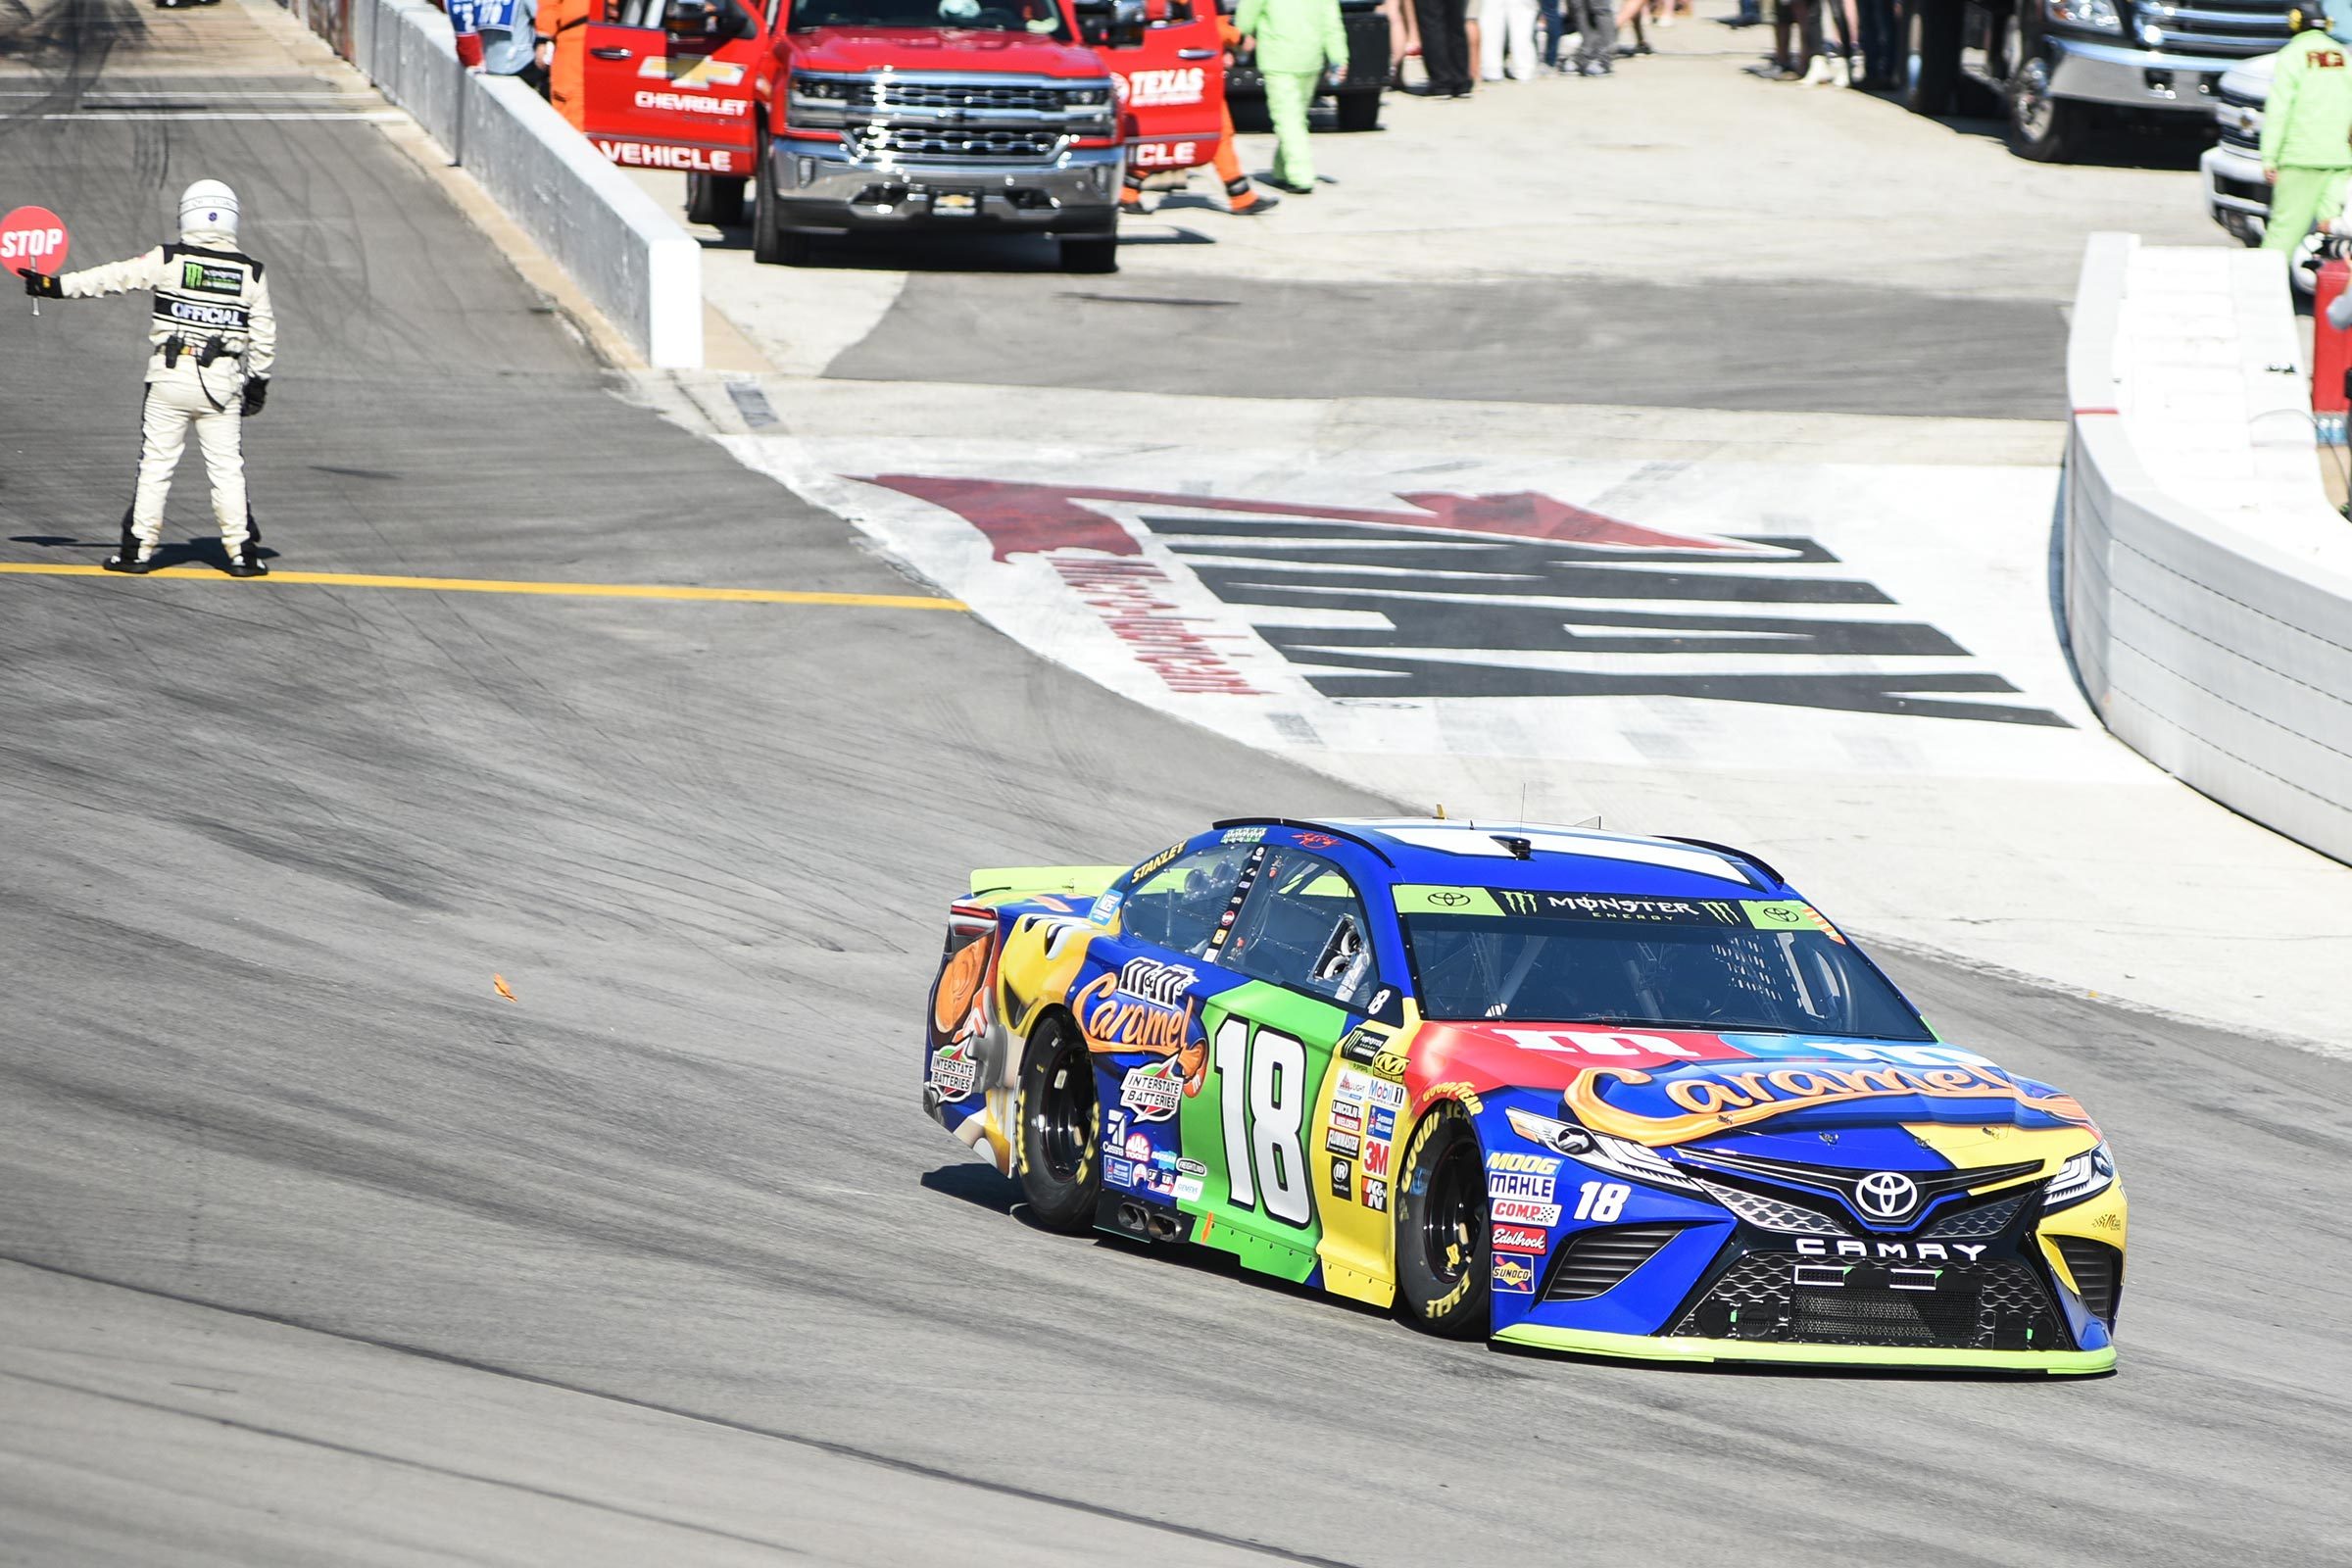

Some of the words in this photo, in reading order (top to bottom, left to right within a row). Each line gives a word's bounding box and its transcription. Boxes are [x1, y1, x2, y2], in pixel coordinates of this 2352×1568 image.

[1129, 68, 1204, 95] TEXAS
[635, 91, 748, 116] CHEVROLET
[599, 141, 733, 172] VEHICLE
[0, 228, 64, 259] STOP
[171, 302, 244, 326] OFFICIAL
[1132, 838, 1188, 883] STANLEY
[1592, 911, 1673, 921] ENERGY
[1073, 972, 1194, 1052] Caramel
[933, 1056, 974, 1076] INTERSTATE
[934, 1071, 971, 1090] BATTERIES
[1127, 1075, 1181, 1095] INTERSTATE
[1369, 1079, 1394, 1101] Mobil
[1394, 1086, 1403, 1103] 1
[1127, 1090, 1176, 1108] BATTERIES
[1333, 1102, 1358, 1119] LINCOLN
[1422, 1081, 1485, 1116] GOODYEAR
[1564, 1062, 2017, 1147] Caramel
[1214, 1013, 1311, 1229] 18
[1364, 1141, 1390, 1176] 3M
[1487, 1152, 1560, 1174] MOOG
[1490, 1174, 1552, 1198] MAHLE
[1494, 1201, 1542, 1218] COMP
[1574, 1181, 1632, 1223] 18
[1493, 1228, 1546, 1250] Edelbrock
[1795, 1238, 1987, 1261] CAMRY
[1494, 1267, 1530, 1281] SUNOCO
